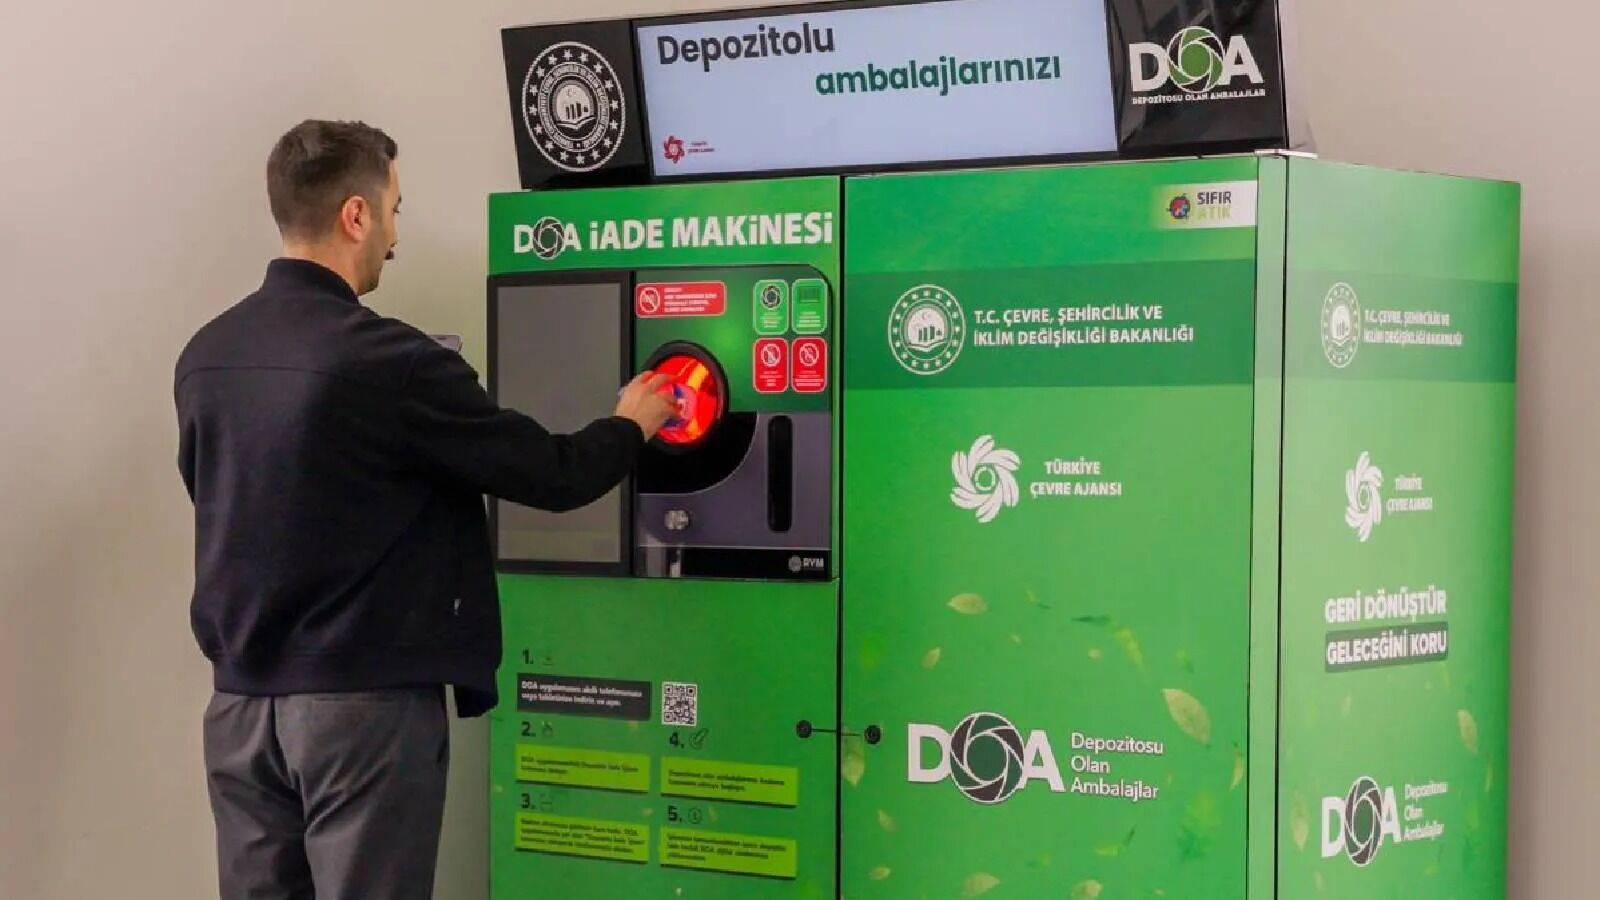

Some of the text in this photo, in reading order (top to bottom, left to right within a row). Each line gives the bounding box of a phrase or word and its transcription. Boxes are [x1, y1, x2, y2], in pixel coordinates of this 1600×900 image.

[658, 22, 835, 71] Depozitolu
[1128, 26, 1264, 94] DOA
[815, 56, 1061, 96] ambalajlarınızı
[1197, 191, 1232, 205] SIFIR
[974, 303, 1163, 327] T.C. ÇEVRE, ŞEHİRCİLİK VE
[974, 324, 1194, 348] İKLİM DEĞİŞİKLİĞİ BAKANLIĞI
[1044, 456, 1101, 475] TÜRKİYE
[1030, 481, 1122, 499] ÇEVRE AJANSI
[1325, 584, 1447, 624] GERİ DÖNÜŞTÜR
[1327, 628, 1447, 665] GELECEĞİNİ KORU
[1071, 732, 1164, 755] Depozitosu
[907, 712, 1066, 804] DOA
[1071, 755, 1111, 775] Olan
[1071, 777, 1159, 802] Ambalajlar
